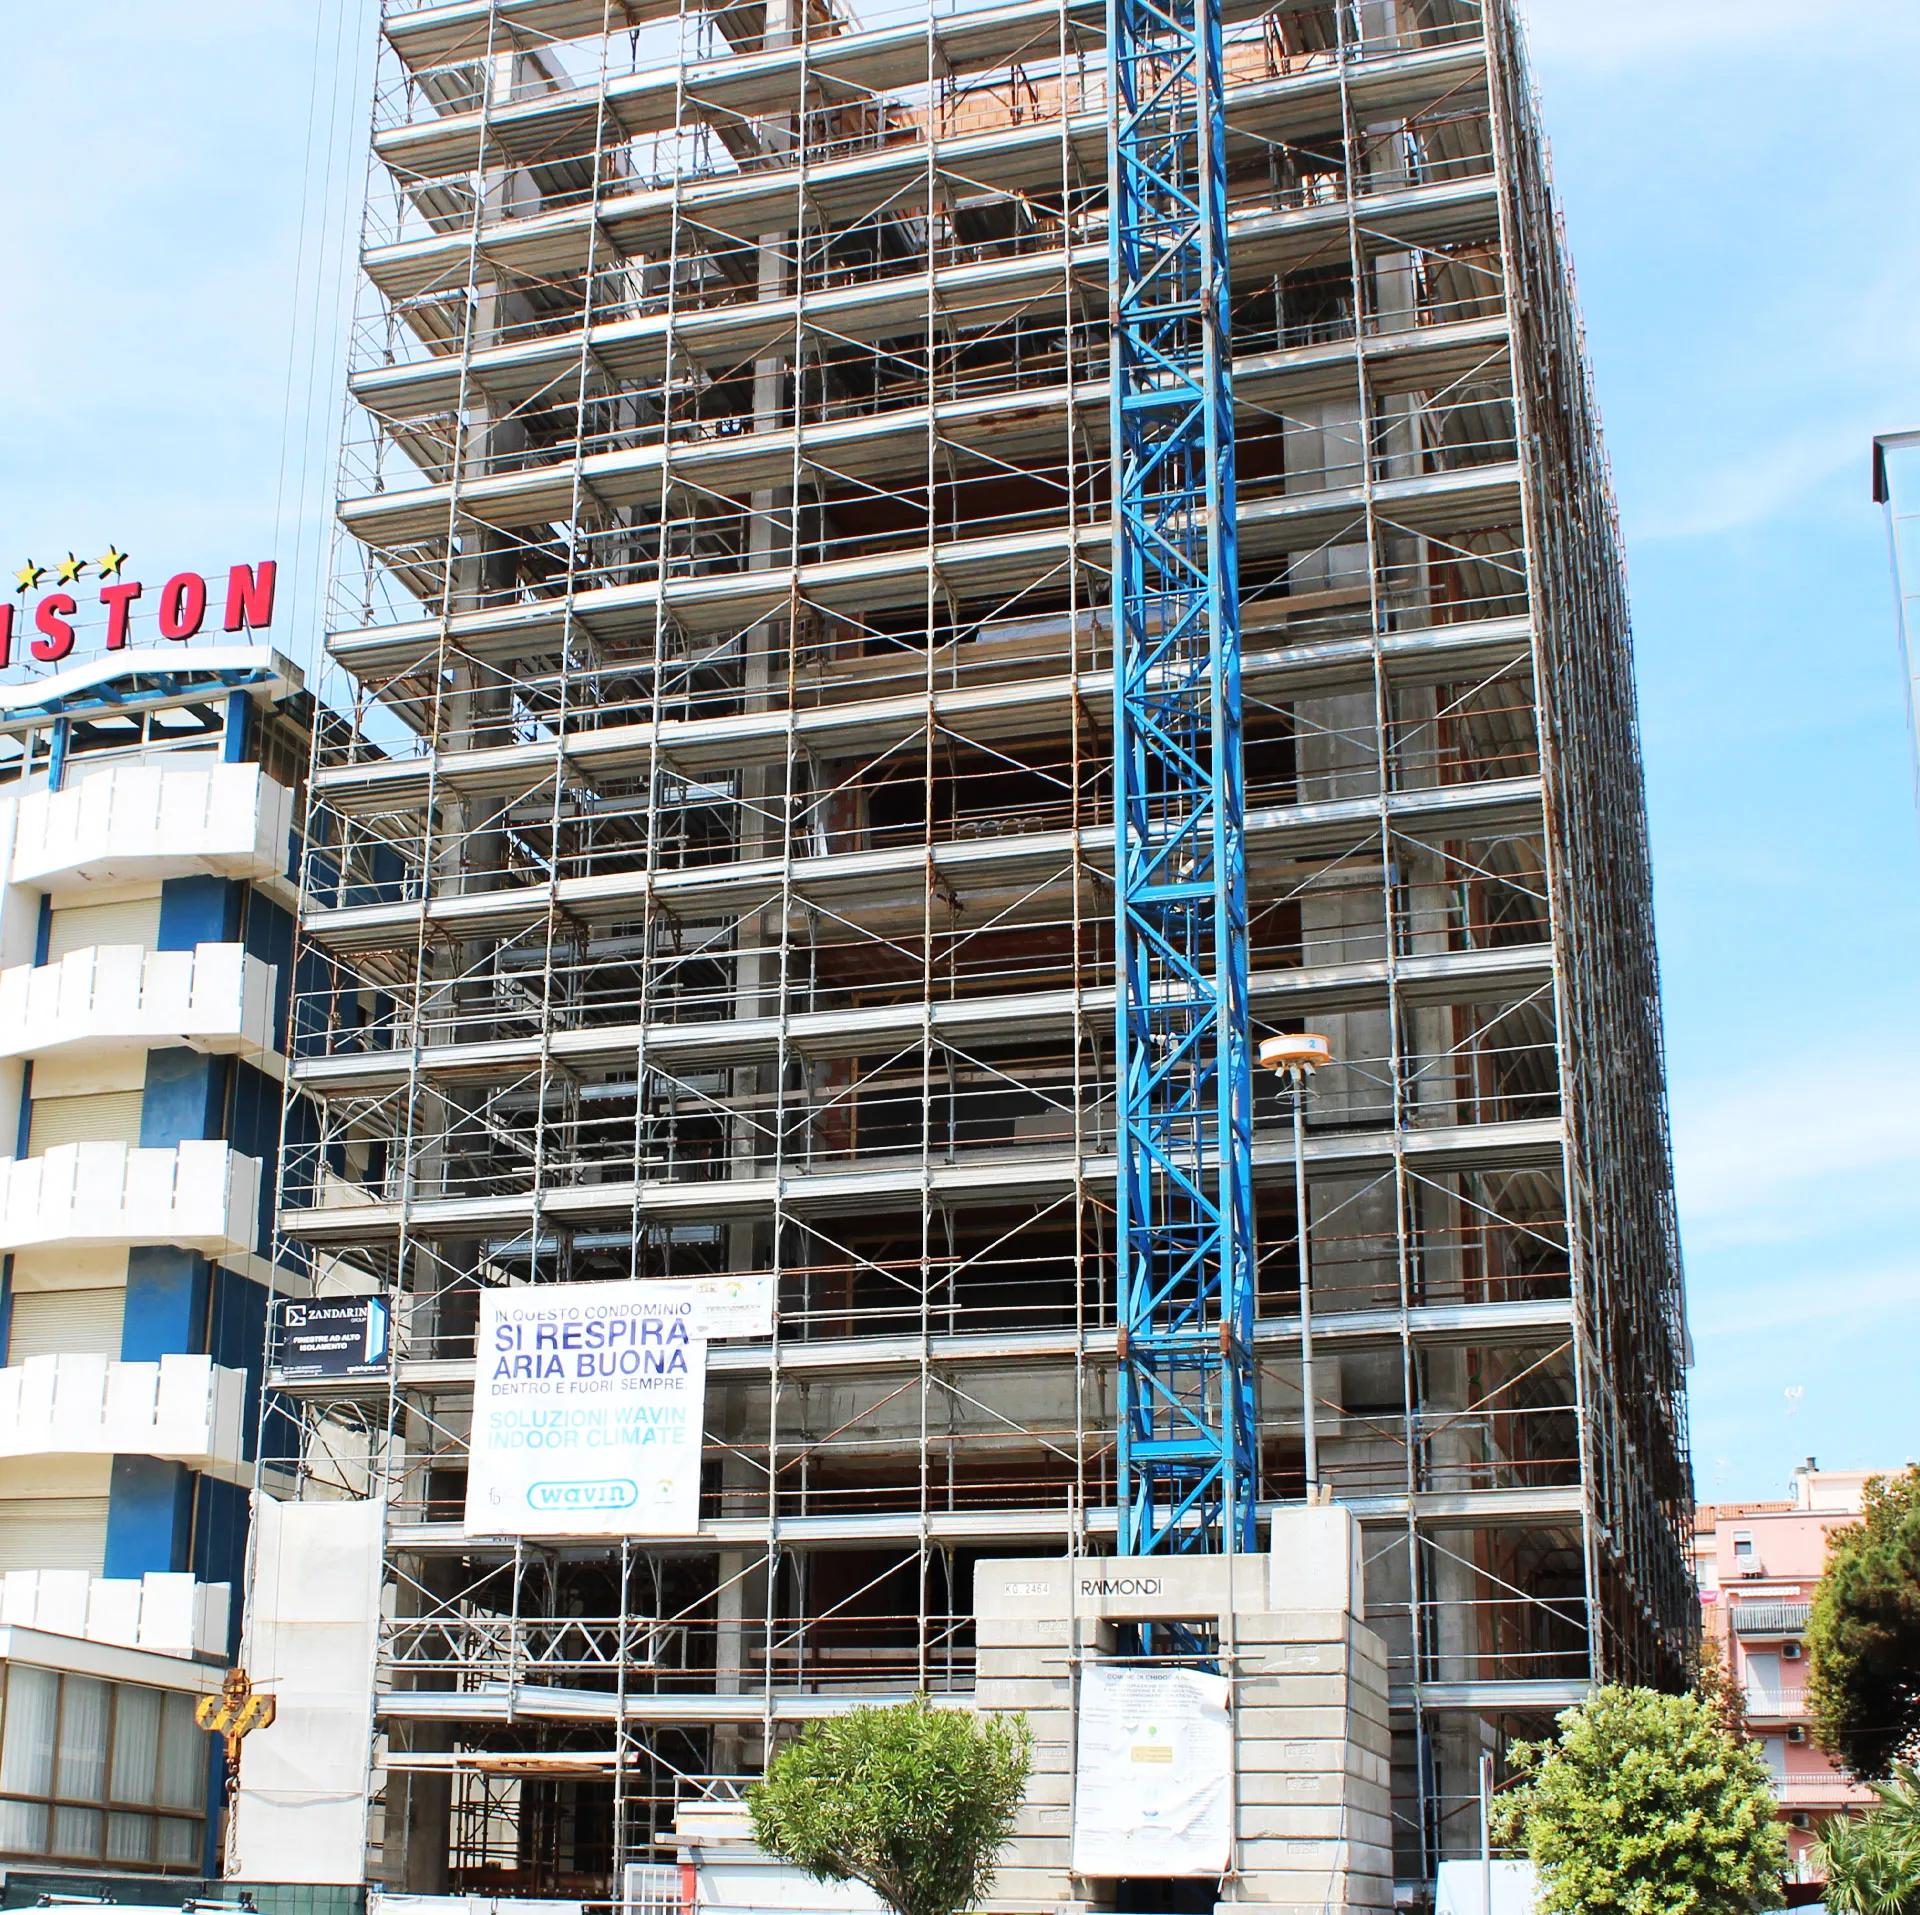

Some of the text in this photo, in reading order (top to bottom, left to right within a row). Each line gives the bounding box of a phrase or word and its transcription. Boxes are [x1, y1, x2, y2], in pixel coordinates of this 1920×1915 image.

[308, 1307, 367, 1320] ZANDARIN
[495, 1309, 508, 1323] IN
[512, 1306, 580, 1322] QUESTO
[584, 1302, 691, 1320] CONDOMINIO
[293, 1335, 329, 1344] FINESTRE
[341, 1333, 361, 1341] ALTO
[495, 1323, 522, 1352] SI
[536, 1317, 690, 1350] RESPIRA
[300, 1342, 348, 1352] ISOLAMENTO
[493, 1349, 689, 1380] ARIA BUONA
[491, 1382, 551, 1396] DENTRO
[556, 1382, 566, 1394] E
[570, 1380, 613, 1394] FUORI
[490, 1406, 687, 1429] SOLUZIONI WAVIN
[488, 1425, 686, 1449] INDOOR CLIMATE
[540, 1486, 625, 1504] wavin
[1081, 1578, 1161, 1596] RAIMONDI
